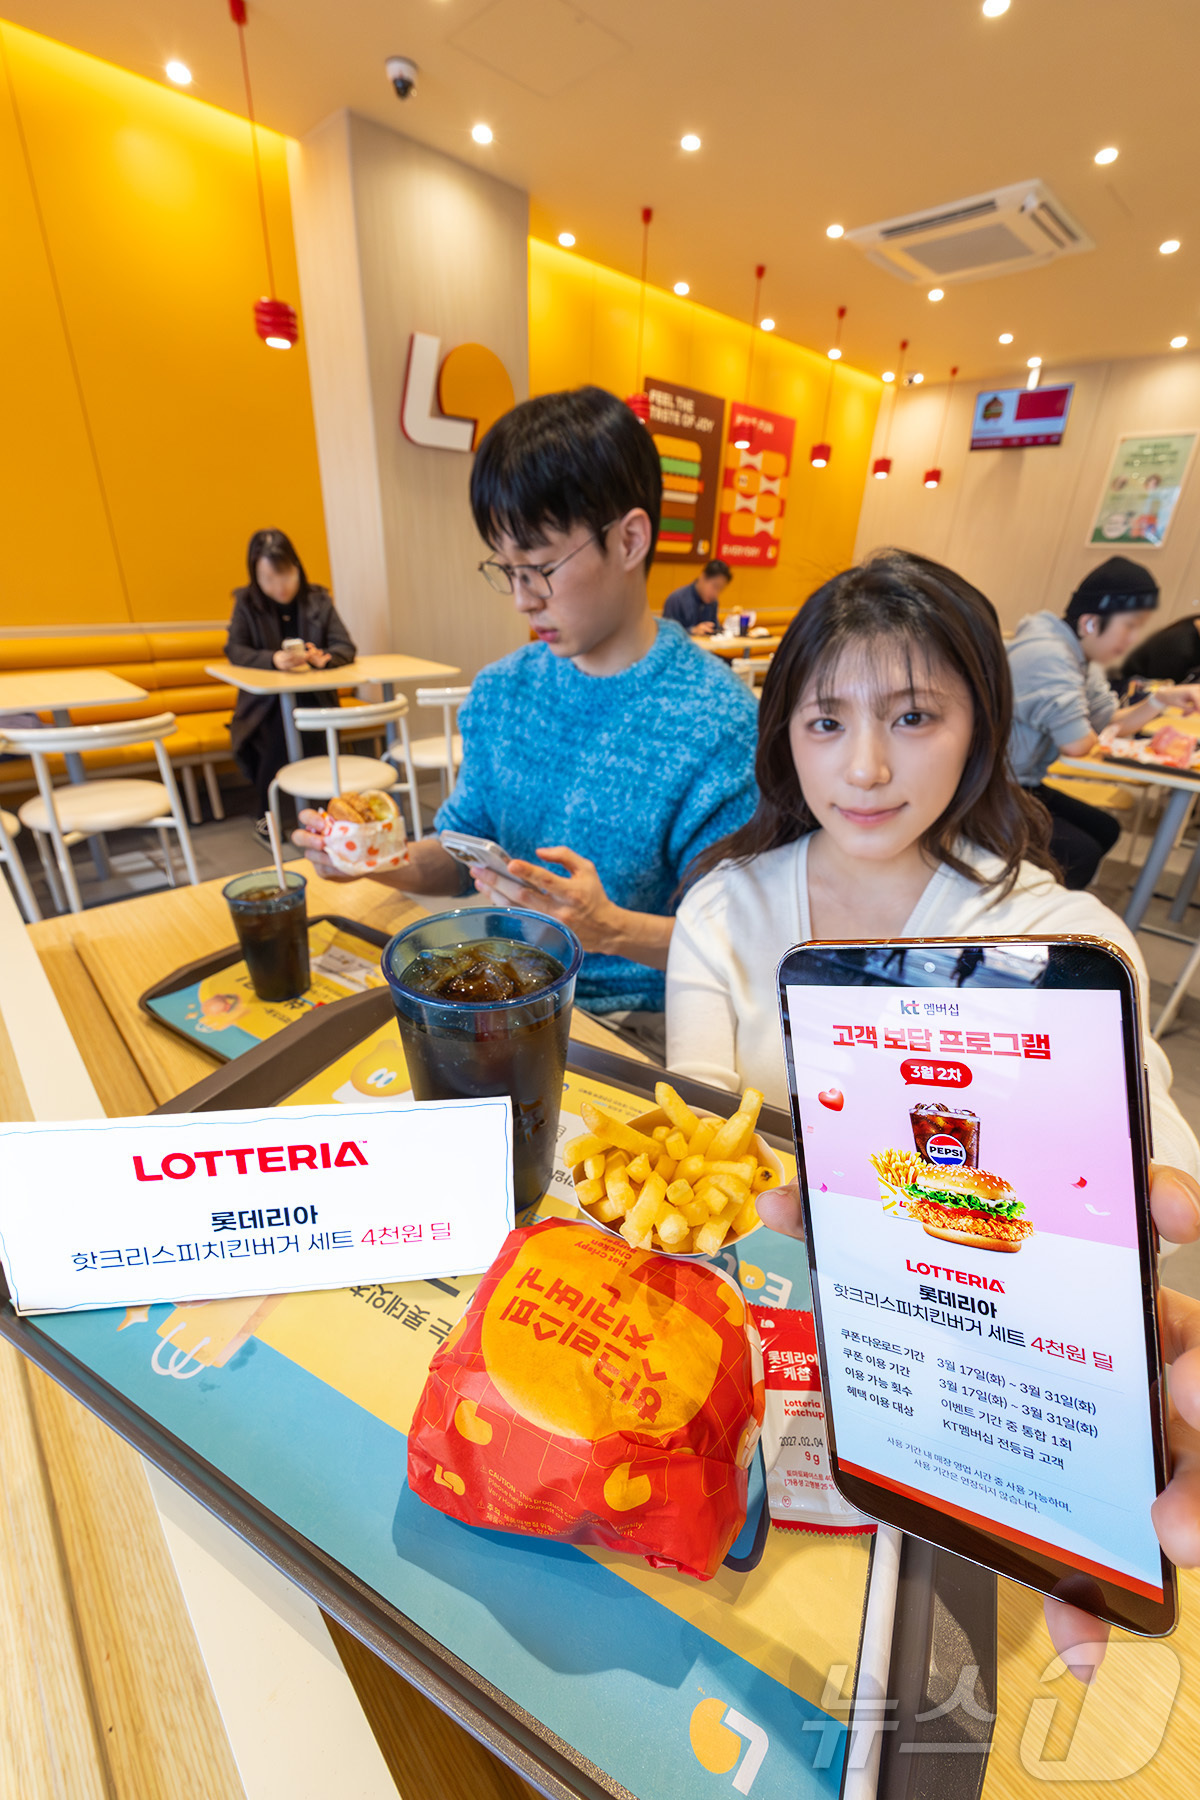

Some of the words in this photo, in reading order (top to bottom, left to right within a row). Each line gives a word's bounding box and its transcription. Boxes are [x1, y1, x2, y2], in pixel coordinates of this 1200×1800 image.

[648, 389, 675, 408] FEEL
[675, 395, 695, 413] THE
[649, 404, 681, 426] TASTE
[681, 412, 696, 428] OF
[695, 416, 715, 434] JOY
[900, 1000, 920, 1015] kt
[923, 1003, 960, 1016] 멤버십
[832, 1024, 878, 1049] 고객
[884, 1027, 933, 1052] 보답
[939, 1029, 1051, 1060] 프로그램
[910, 1065, 934, 1080] 3월
[937, 1067, 962, 1082] 2차
[132, 1141, 369, 1182] LOTTERIA
[929, 1146, 963, 1158] PEPSI
[211, 1205, 319, 1233] 롯데리아
[71, 1234, 300, 1272] 핫크리스피치킨버거
[308, 1230, 355, 1251] 세트
[361, 1224, 423, 1246] 4천원
[430, 1222, 452, 1240] 딜
[574, 1241, 611, 1261] Crispy
[591, 1239, 632, 1259] Chicken
[613, 1254, 628, 1268] Hot
[906, 1259, 1006, 1294] LOTTERIA
[516, 1266, 655, 1351] 치킨버거
[919, 1284, 998, 1319] 롯데리아
[833, 1283, 982, 1337] 핫크리스피치킨버거
[988, 1323, 1026, 1348] 세트
[1030, 1336, 1086, 1365] 4천원
[1092, 1350, 1115, 1373] 딜
[499, 1296, 668, 1423] 핫크리스피
[843, 1347, 863, 1363] 쿠폰
[866, 1355, 887, 1370] 이용
[889, 1362, 910, 1378] 기간
[904, 1347, 925, 1363] 기간
[845, 1367, 865, 1381] 이용
[867, 1374, 888, 1389] 가능
[891, 1381, 912, 1397] 횟수
[937, 1358, 956, 1373] 3월
[960, 1365, 1006, 1388] 17일(화)
[1019, 1383, 1040, 1398] 3월
[1045, 1390, 1097, 1416] 31일(화)
[784, 1399, 820, 1409] Lotteria
[784, 1408, 825, 1420] Ketchup
[846, 1385, 867, 1401] 혜택
[869, 1394, 890, 1409] 이용
[892, 1401, 914, 1417] 대상
[939, 1379, 958, 1394] 3월
[962, 1386, 1008, 1410] 17일(화)
[1021, 1405, 1043, 1421] 3월
[1046, 1412, 1098, 1439] 31일(화)
[941, 1399, 976, 1418] 이벤트
[979, 1410, 1002, 1428] 기간
[1006, 1419, 1018, 1433] 중
[1022, 1425, 1047, 1443] 통합
[1052, 1435, 1072, 1452] 1회
[779, 1436, 824, 1448] 2027.02.04
[943, 1419, 994, 1446] KT멤버십
[998, 1437, 1035, 1460] 전등급
[1038, 1452, 1064, 1470] 고객
[887, 1436, 903, 1449] 사용
[905, 1442, 921, 1456] 기간
[923, 1449, 933, 1460] 내
[934, 1453, 952, 1468] 매장
[953, 1461, 972, 1475] 영업
[973, 1469, 992, 1482] 시간
[994, 1476, 1004, 1487] 중
[1006, 1481, 1025, 1496] 사용
[1028, 1488, 1072, 1513] 가능하며.
[914, 1459, 930, 1471] 사용
[933, 1465, 959, 1482] 기간은
[960, 1475, 997, 1497] 연장되지
[999, 1490, 1040, 1513] 않습니다.
